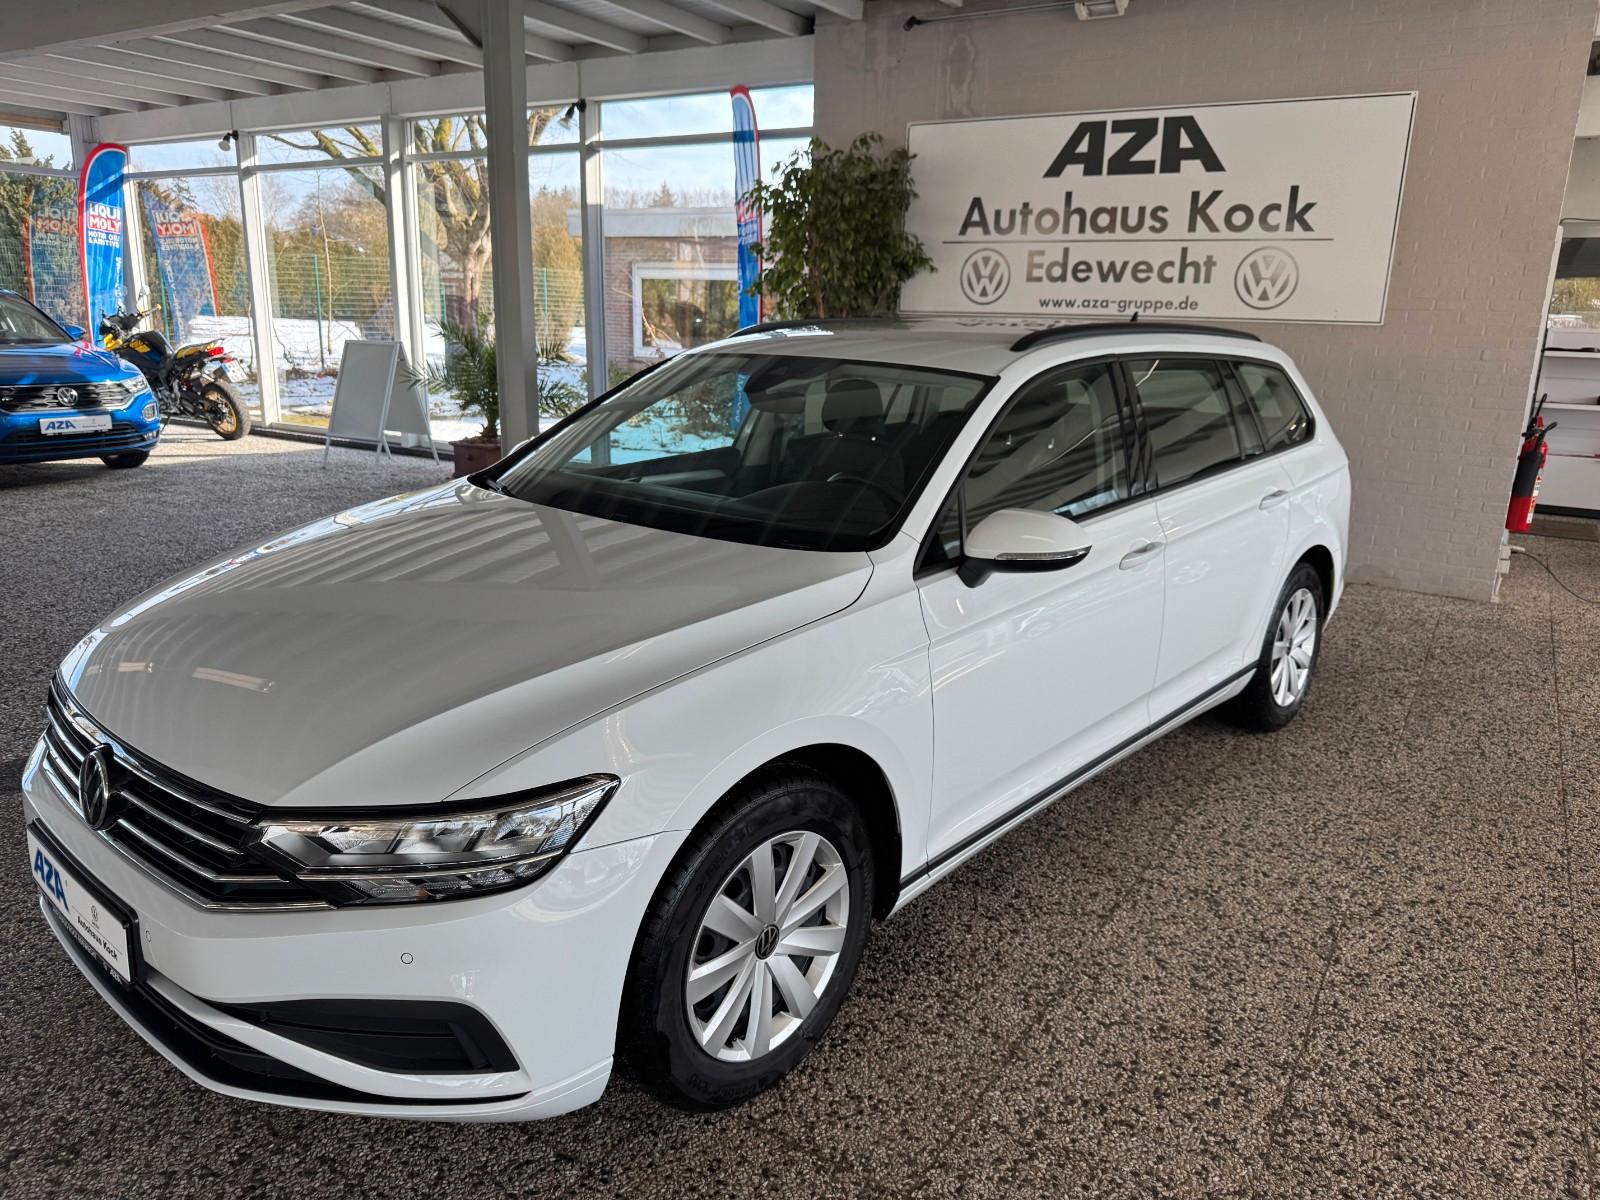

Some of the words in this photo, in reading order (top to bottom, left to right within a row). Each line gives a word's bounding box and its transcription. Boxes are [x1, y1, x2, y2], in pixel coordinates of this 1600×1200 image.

[1042, 115, 1226, 178] AZA
[89, 203, 121, 221] LIQUI
[89, 215, 121, 233] MOLY
[958, 191, 1169, 237] Autohaus
[1187, 185, 1318, 233] Kock
[1025, 247, 1217, 284] Edewecht
[1038, 295, 1199, 313] www.aza-gruppe.de
[45, 420, 77, 430] AZA
[34, 848, 70, 915] AZA
